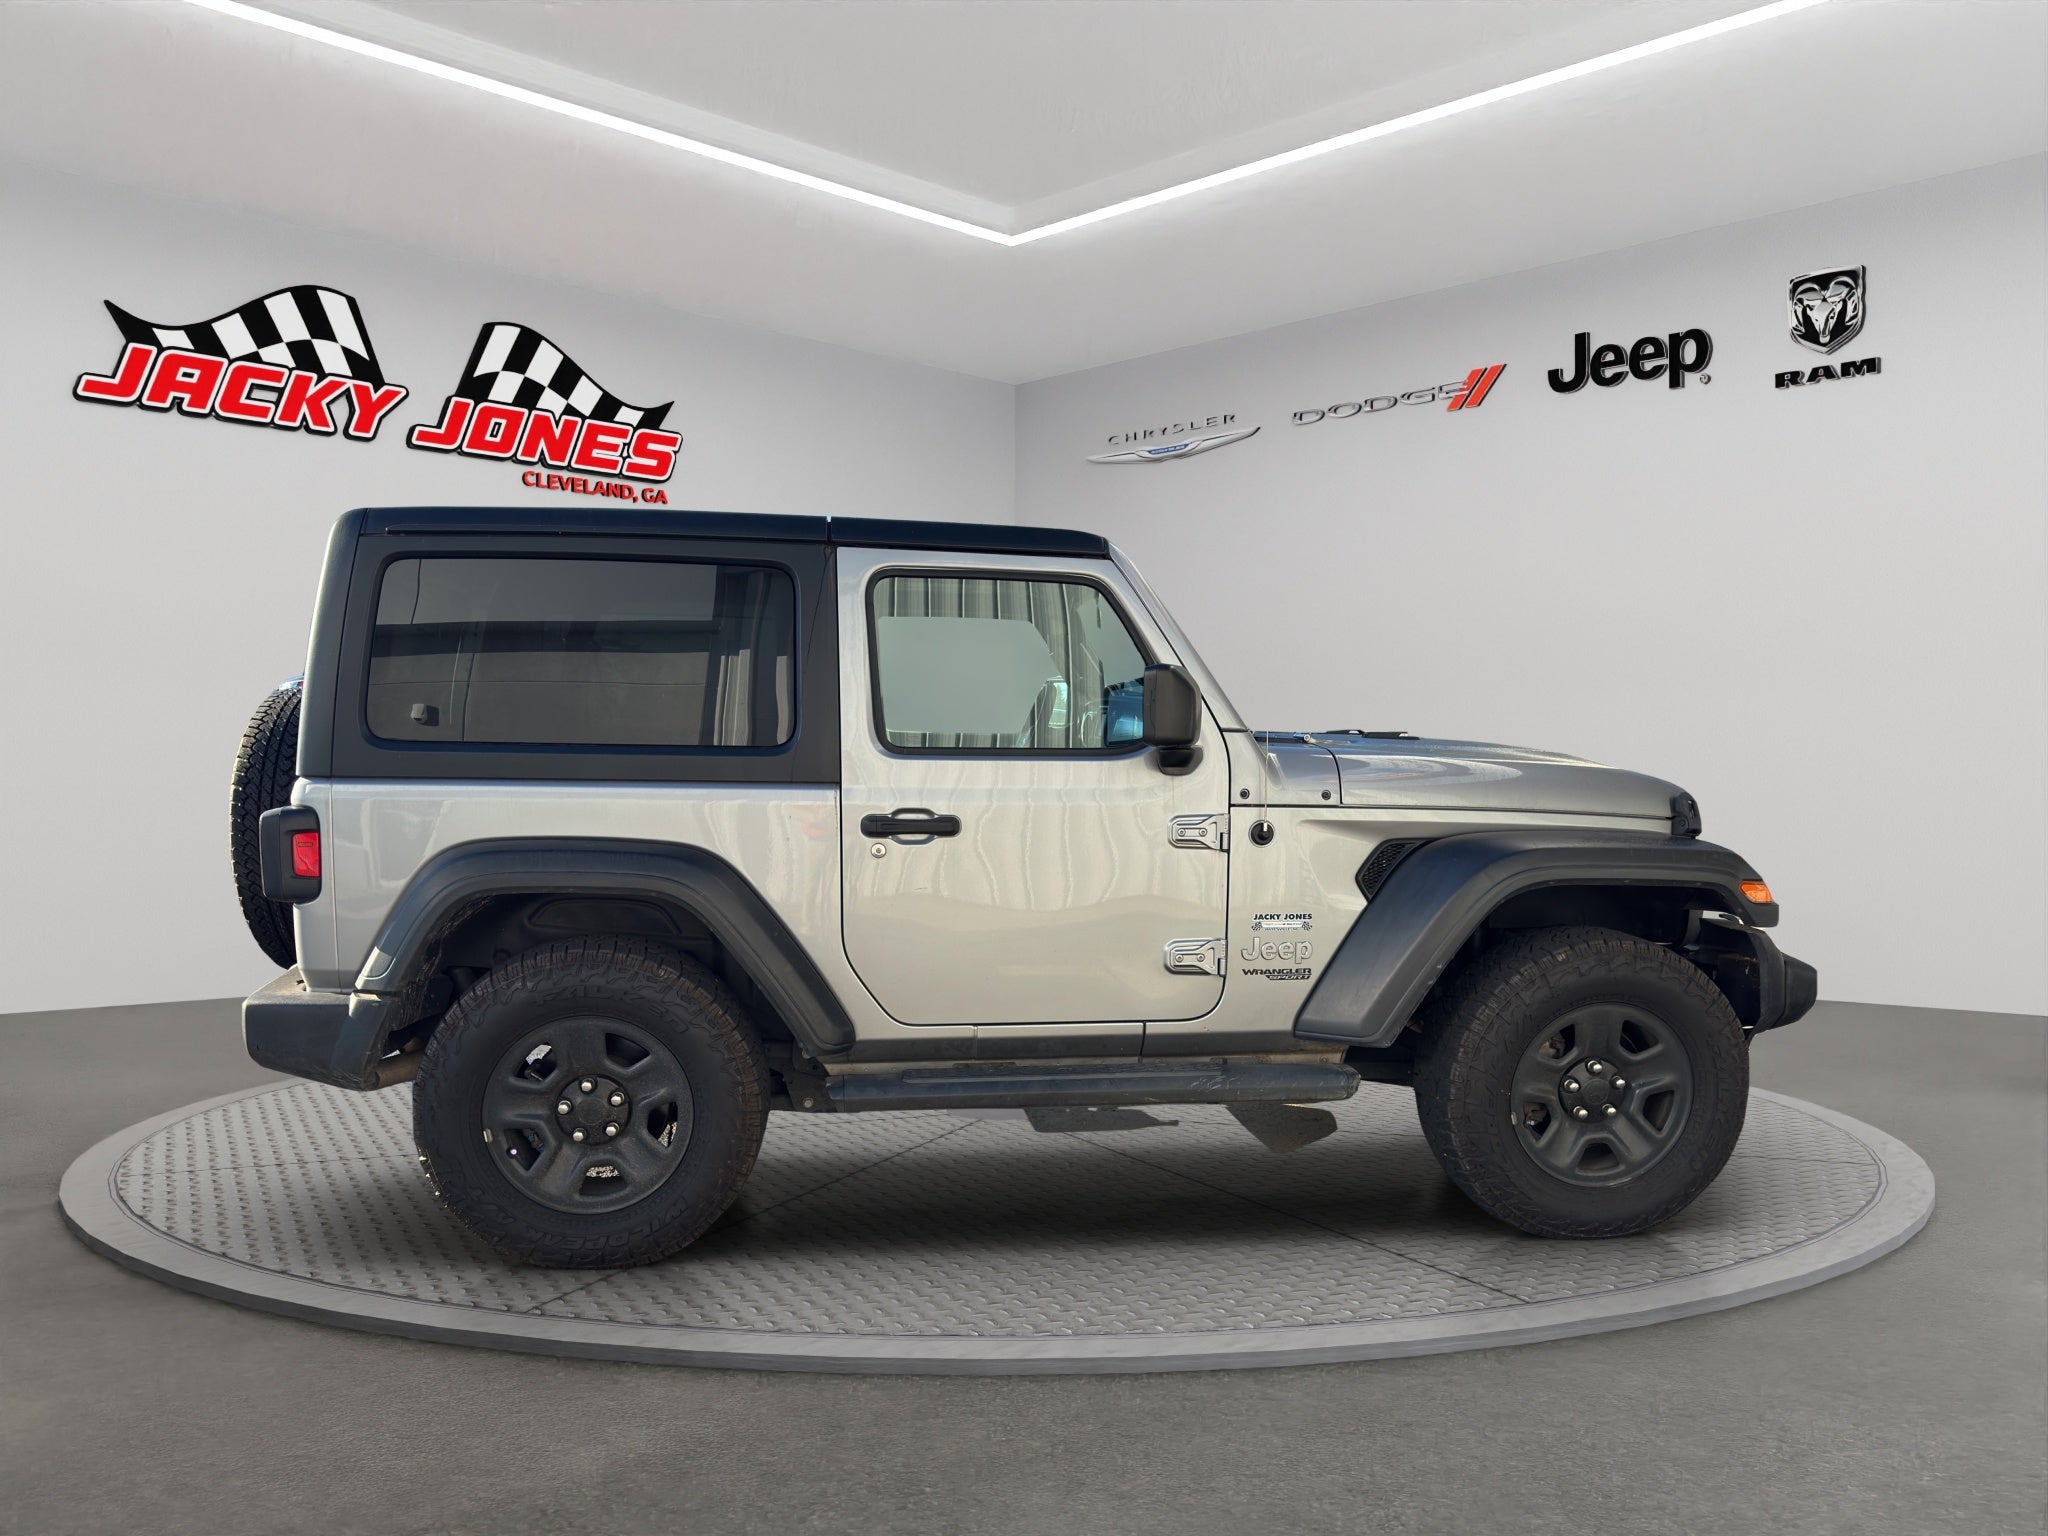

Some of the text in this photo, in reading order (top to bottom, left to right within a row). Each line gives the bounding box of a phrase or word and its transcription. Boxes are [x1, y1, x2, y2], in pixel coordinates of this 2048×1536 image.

[1548, 328, 1713, 393] Jeep
[1774, 356, 1882, 390] RAM
[75, 342, 683, 483] JACKY JONES
[1292, 380, 1470, 426] DODGE
[1108, 414, 1236, 445] CHRYSLER
[522, 470, 668, 505] CLEVELAND, GA
[1253, 913, 1281, 921] JACKY
[1241, 936, 1313, 965] Jeep
[1241, 967, 1312, 976] WRANGLER
